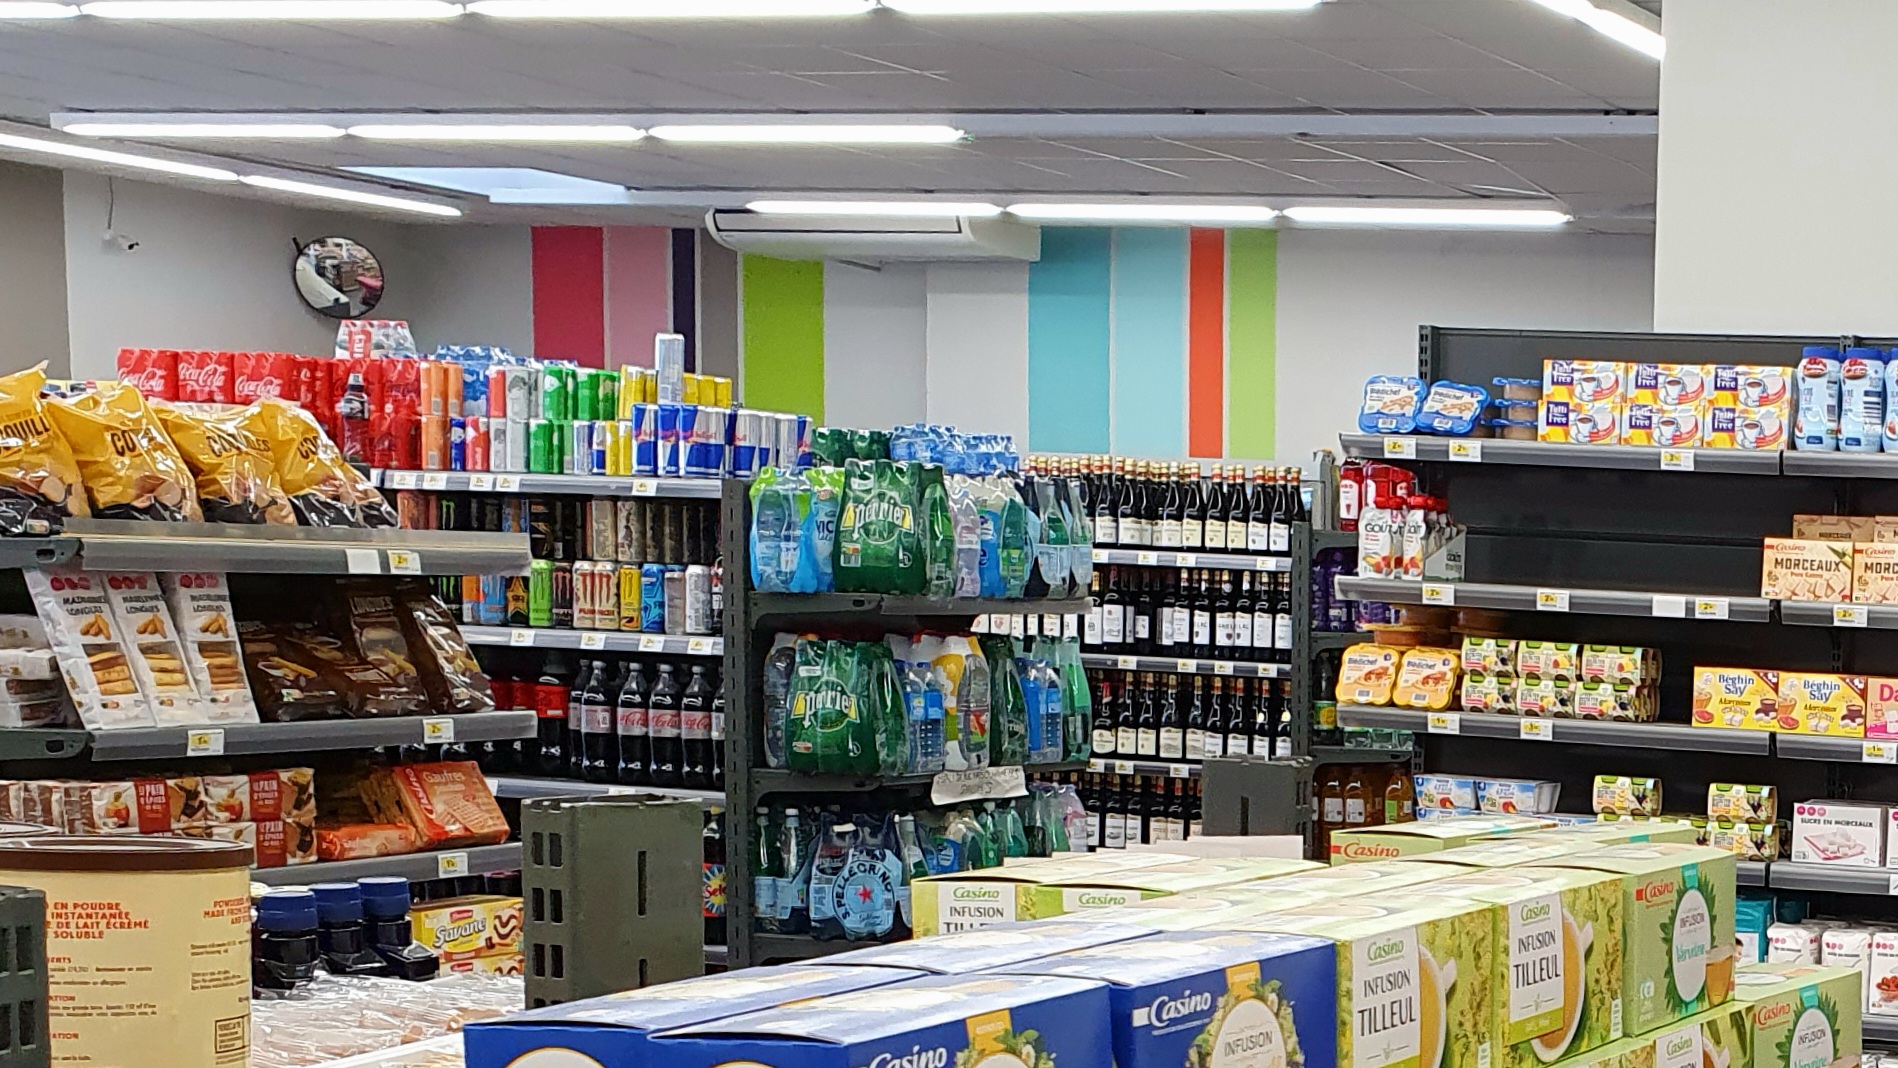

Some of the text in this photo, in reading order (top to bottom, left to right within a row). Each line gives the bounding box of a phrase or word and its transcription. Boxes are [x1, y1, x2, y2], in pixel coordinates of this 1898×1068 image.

[1552, 371, 1573, 384] Free
[1716, 379, 1736, 389] Free
[1548, 412, 1567, 424] Free
[1630, 416, 1650, 427] Free
[852, 499, 905, 541] perrier
[1774, 557, 1841, 573] MORCEAUX
[1718, 673, 1755, 687] Béghin
[1803, 678, 1841, 693] Béghin
[1724, 684, 1746, 698] Say
[1808, 689, 1832, 704] Say
[422, 769, 464, 784] Gaufres
[1801, 817, 1873, 828] SUCRE EN MORCEAUX
[953, 886, 1000, 899] Casino
[1079, 892, 1126, 906] Casino
[53, 902, 121, 911] EN POUDRE
[949, 905, 1004, 918] INFUSION
[56, 919, 149, 930] DE LAIT ÉCRÉMÉ
[435, 916, 486, 948] Savane
[53, 930, 105, 940] SOLUBLE
[1518, 930, 1556, 955] INFUSION
[1513, 954, 1561, 990] TILLEUL
[1363, 968, 1411, 998] INFUSION
[1150, 989, 1212, 1028] Casino
[1357, 995, 1417, 1037] TILLEUL
[1757, 1001, 1791, 1027] Casino
[1224, 1030, 1273, 1058] INFUSION
[1666, 1035, 1693, 1057] Casino
